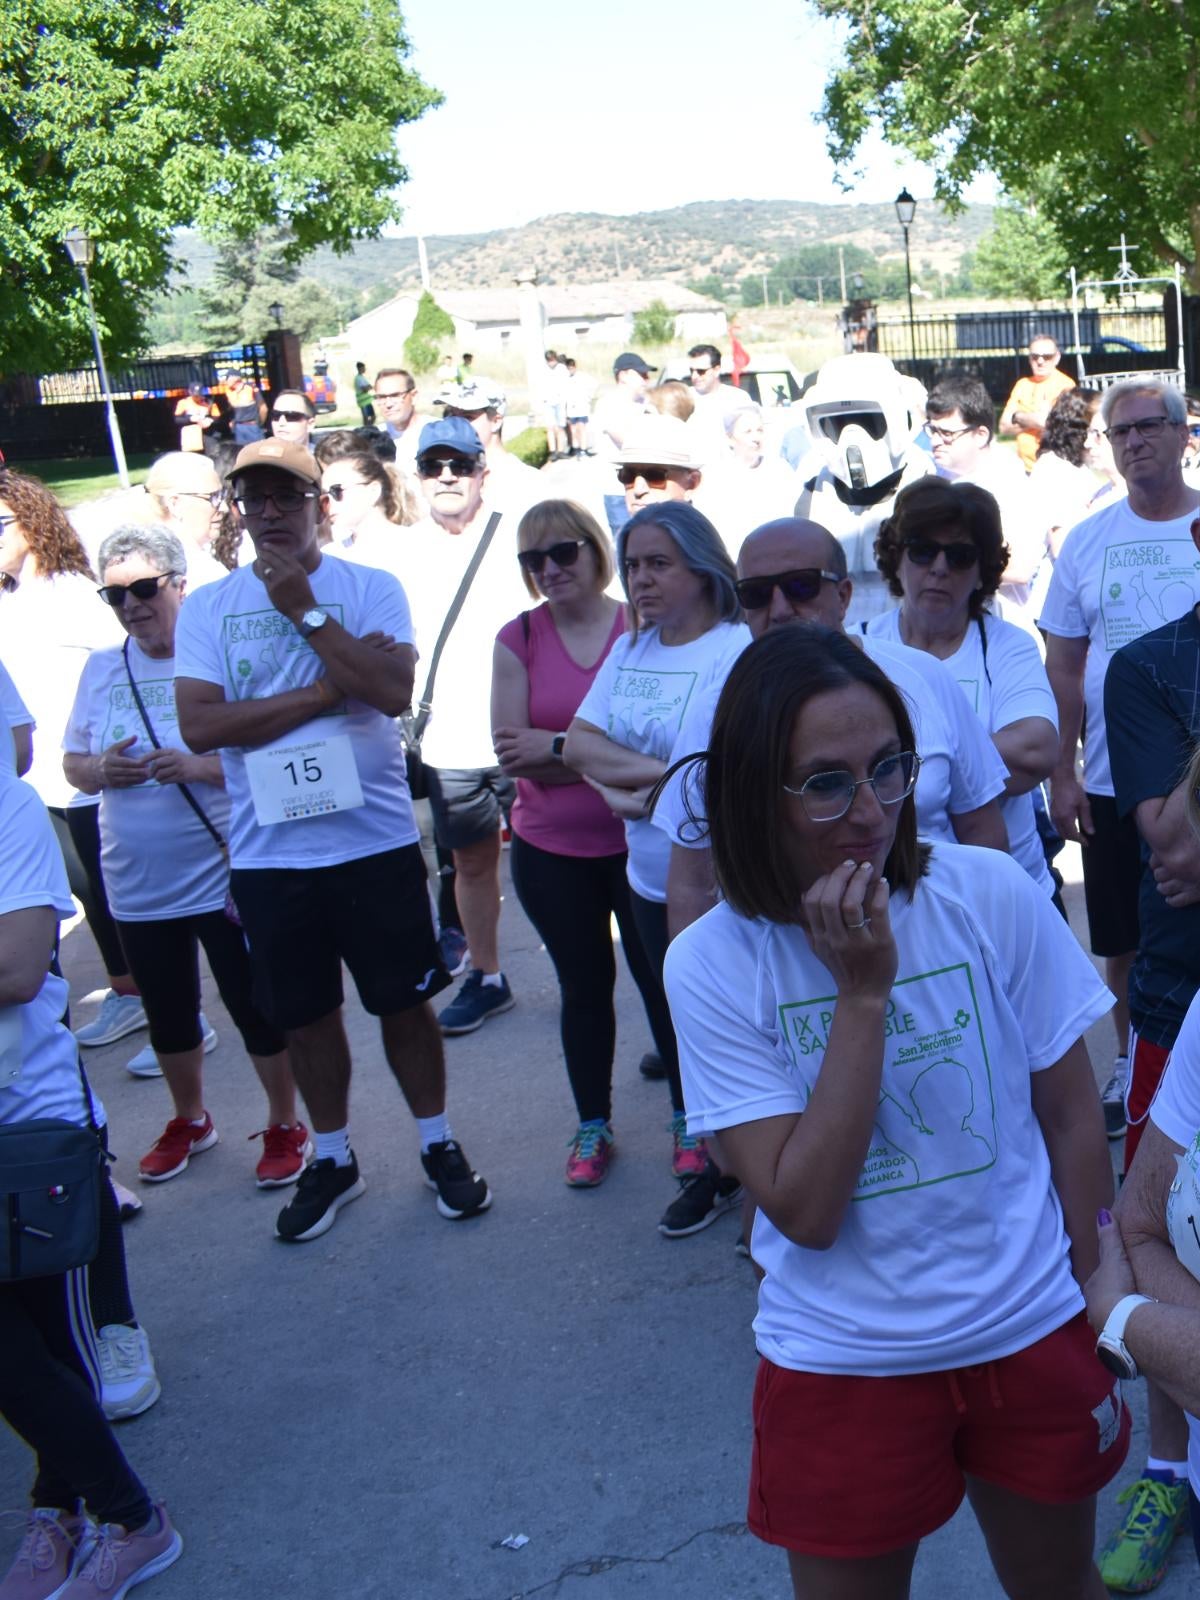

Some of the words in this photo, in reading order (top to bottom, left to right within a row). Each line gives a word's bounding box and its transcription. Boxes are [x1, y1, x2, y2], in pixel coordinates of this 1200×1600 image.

[1124, 545, 1164, 558] PASEO
[1109, 555, 1171, 569] SALUDABLE
[230, 621, 241, 633] IX
[231, 625, 298, 643] SALUDABL
[611, 686, 664, 700] SLUDABLE
[115, 696, 174, 711] SALDABLE
[284, 757, 322, 786] 15
[792, 1014, 813, 1037] IX
[898, 1044, 917, 1059] San
[919, 1033, 962, 1054] Jerónimo
[857, 1169, 905, 1189] LAMANCA
